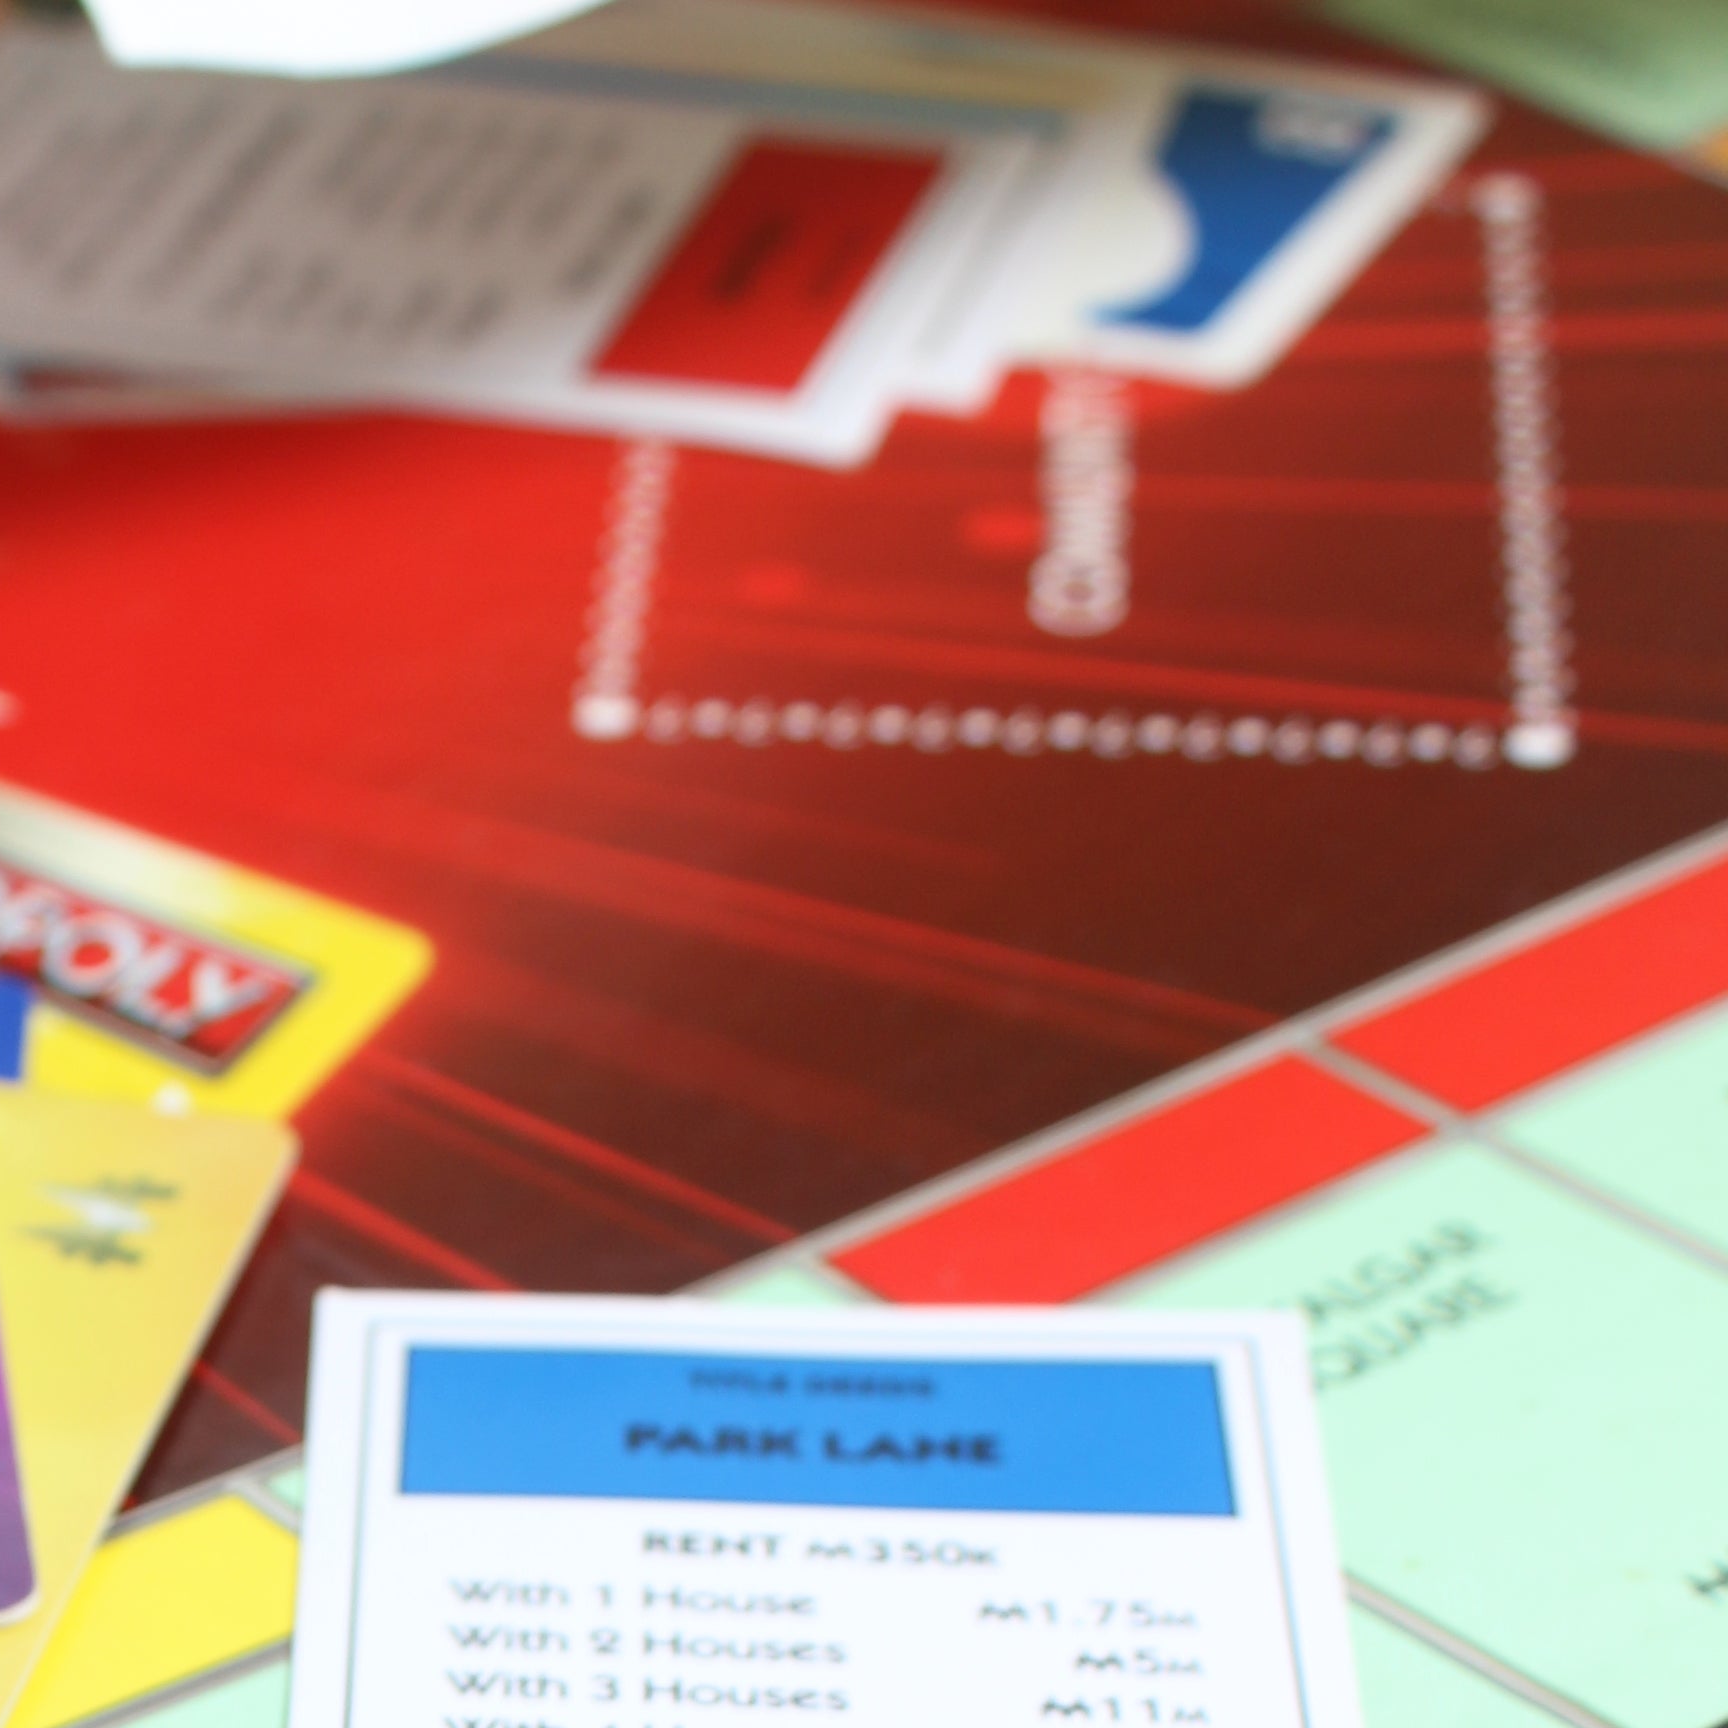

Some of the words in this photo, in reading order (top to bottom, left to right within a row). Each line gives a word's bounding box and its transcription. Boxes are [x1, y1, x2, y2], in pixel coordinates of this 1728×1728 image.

[625, 1422, 800, 1458] PARK
[822, 1430, 1002, 1466] LANE
[642, 1531, 784, 1559] RENT
[448, 1578, 571, 1608] With
[595, 1583, 615, 1608] 1
[641, 1583, 816, 1616] House
[446, 1624, 570, 1654] With
[588, 1628, 620, 1655] 2
[641, 1630, 849, 1664] Houses
[444, 1670, 569, 1700] With
[589, 1673, 620, 1702] 3
[642, 1676, 851, 1712] Houses
